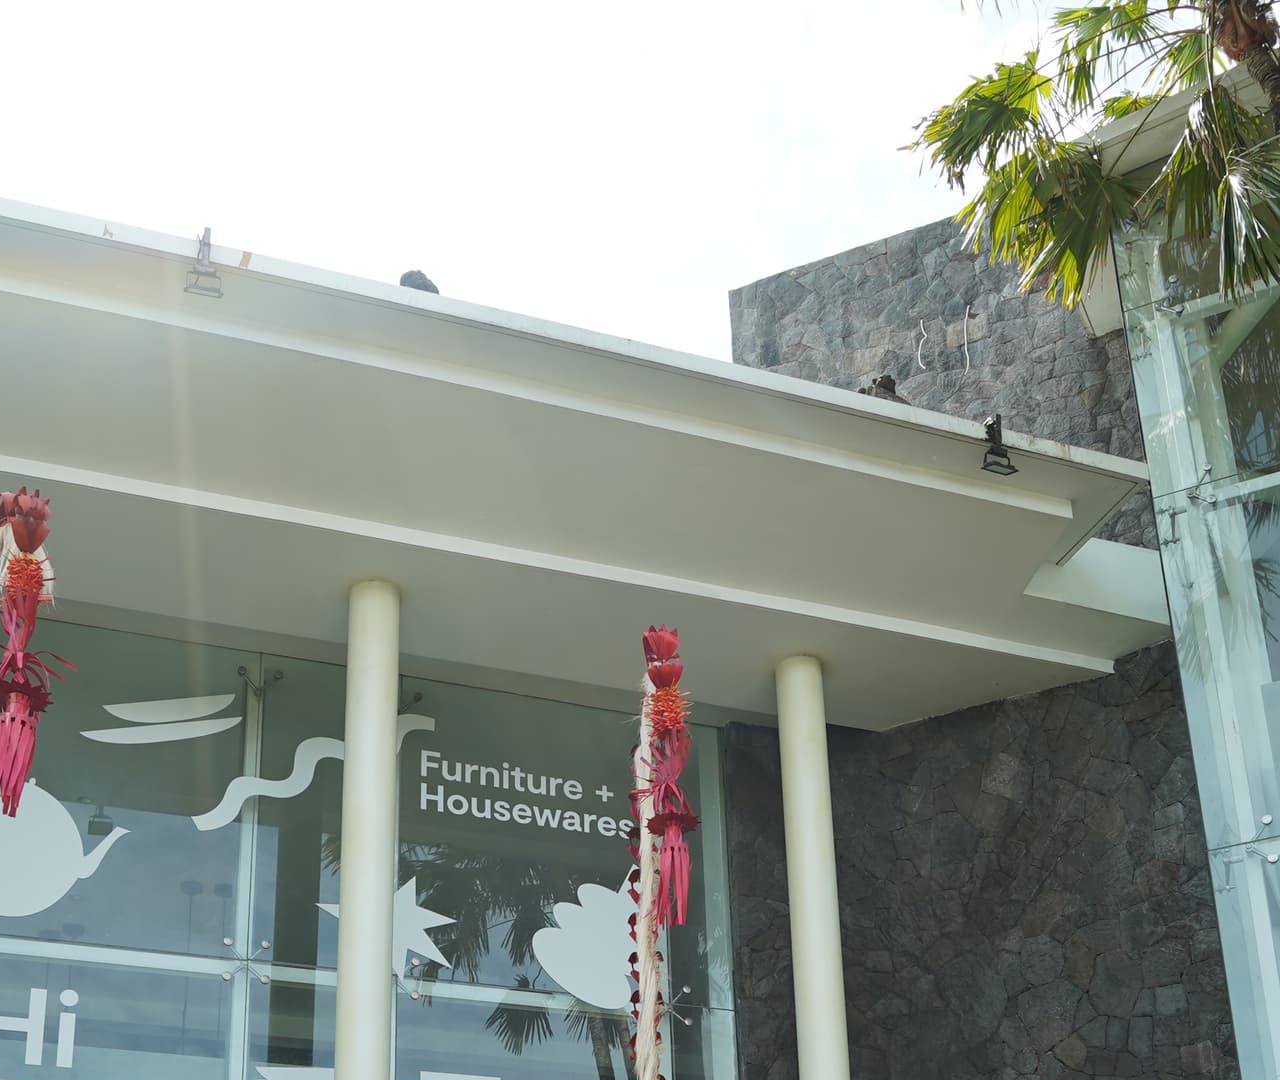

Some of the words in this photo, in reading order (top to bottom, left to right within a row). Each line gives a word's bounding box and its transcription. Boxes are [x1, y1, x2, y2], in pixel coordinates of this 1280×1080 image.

[420, 749, 583, 800] Furniture
[595, 784, 615, 802] +
[420, 782, 635, 840] Housewares
